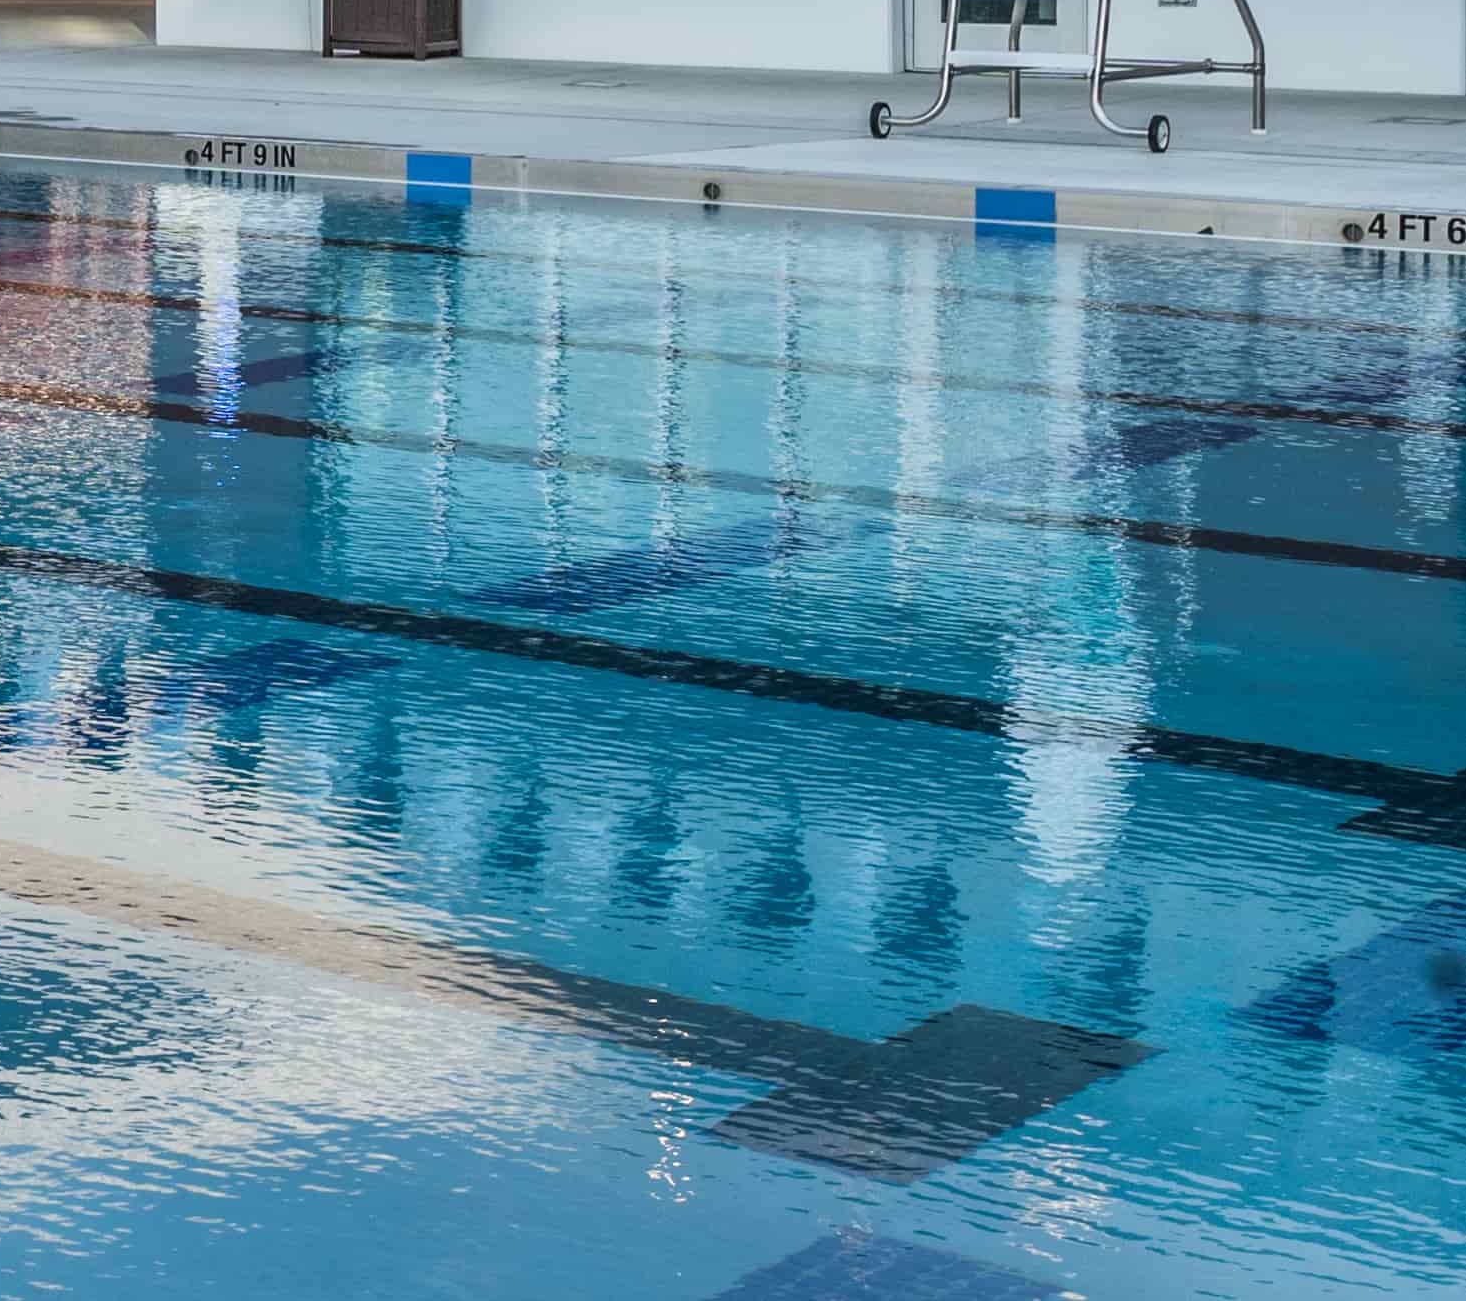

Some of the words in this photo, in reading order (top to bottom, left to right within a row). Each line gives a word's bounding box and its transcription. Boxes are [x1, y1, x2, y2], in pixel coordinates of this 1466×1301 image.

[201, 140, 214, 163] 4
[221, 141, 247, 164] FT
[253, 143, 267, 166] 9
[274, 145, 296, 168] IN
[1367, 212, 1388, 240] 4
[1399, 214, 1438, 242] FT
[1447, 217, 1466, 245] 6
